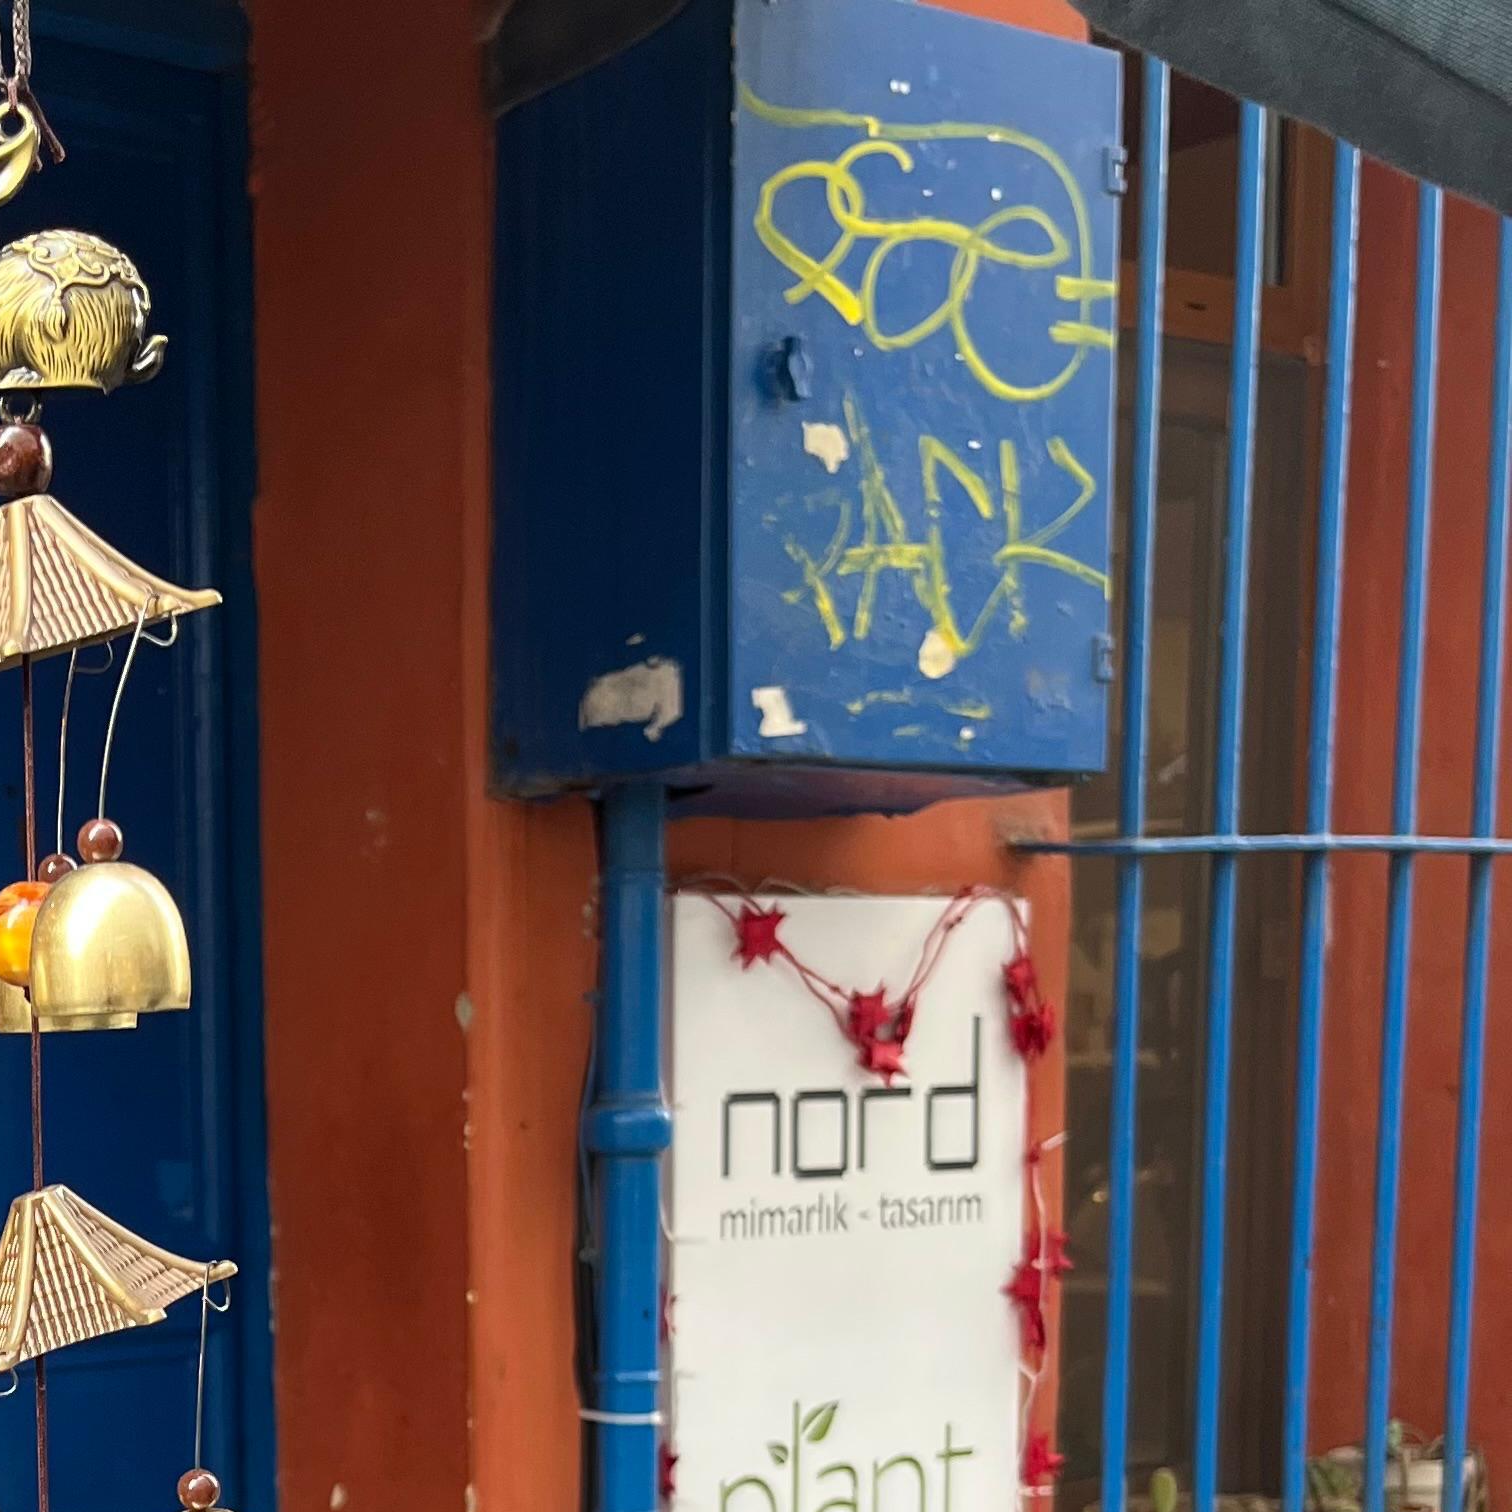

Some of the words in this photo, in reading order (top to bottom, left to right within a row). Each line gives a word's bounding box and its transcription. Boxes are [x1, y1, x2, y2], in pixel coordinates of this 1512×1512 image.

[721, 1014, 982, 1178] nord
[719, 1189, 849, 1240] mimarlık
[877, 1192, 983, 1230] tasarım
